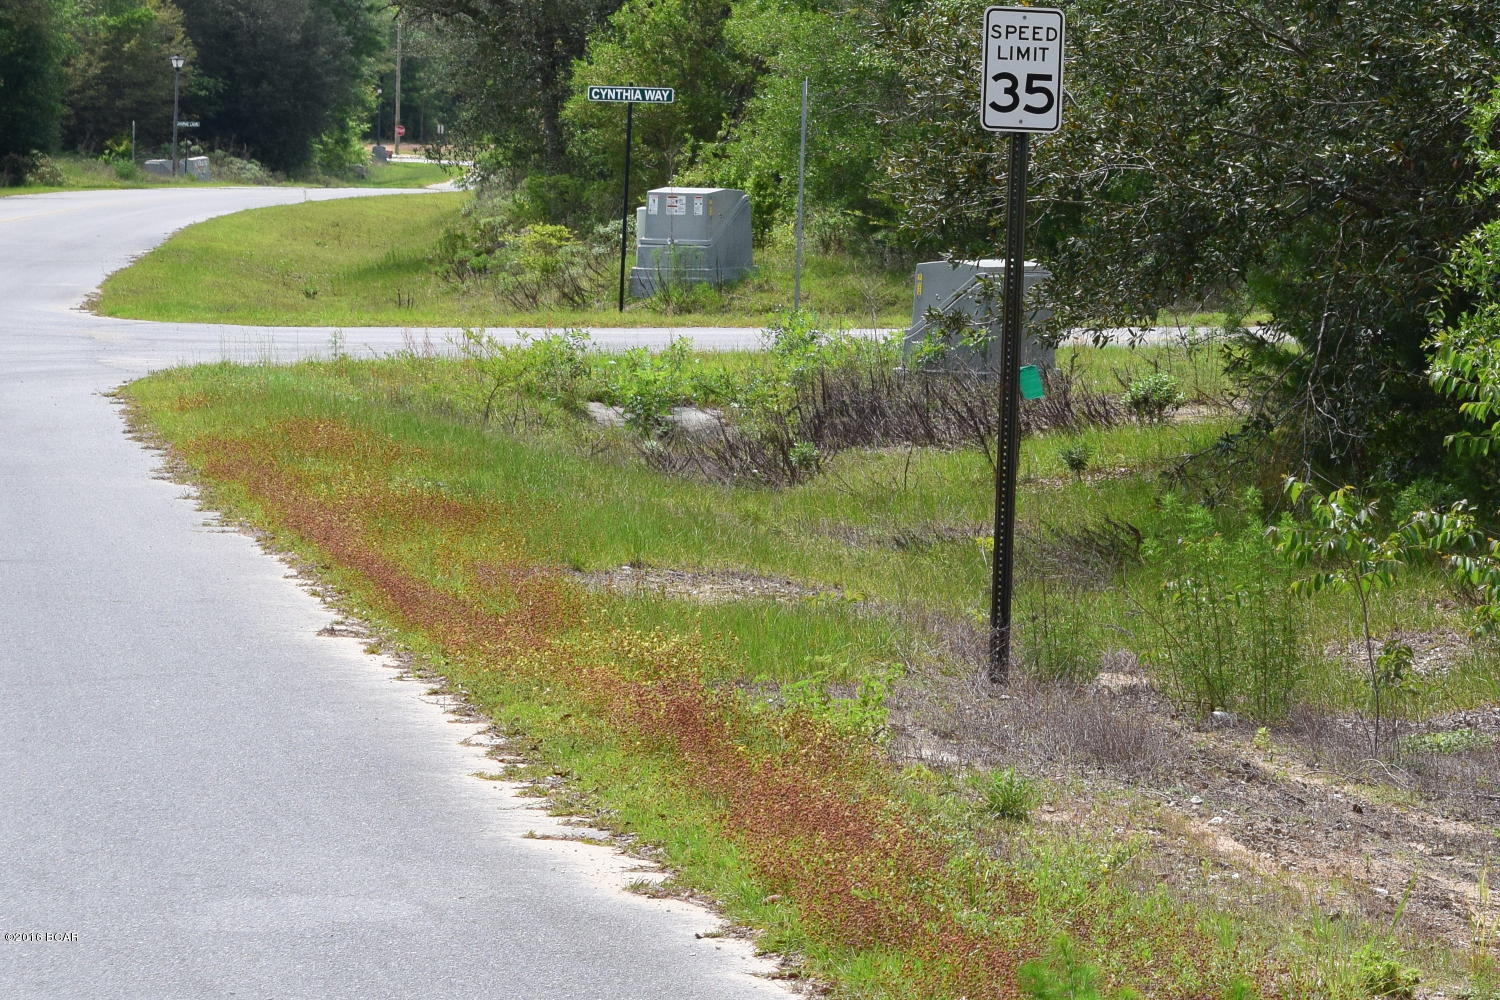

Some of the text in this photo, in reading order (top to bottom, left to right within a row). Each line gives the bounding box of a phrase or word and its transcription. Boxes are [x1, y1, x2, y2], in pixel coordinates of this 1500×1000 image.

[990, 24, 1058, 42] SPEED
[997, 45, 1050, 62] LIMIT
[591, 88, 670, 102] CYNTHIA WAY
[988, 71, 1055, 115] 35
